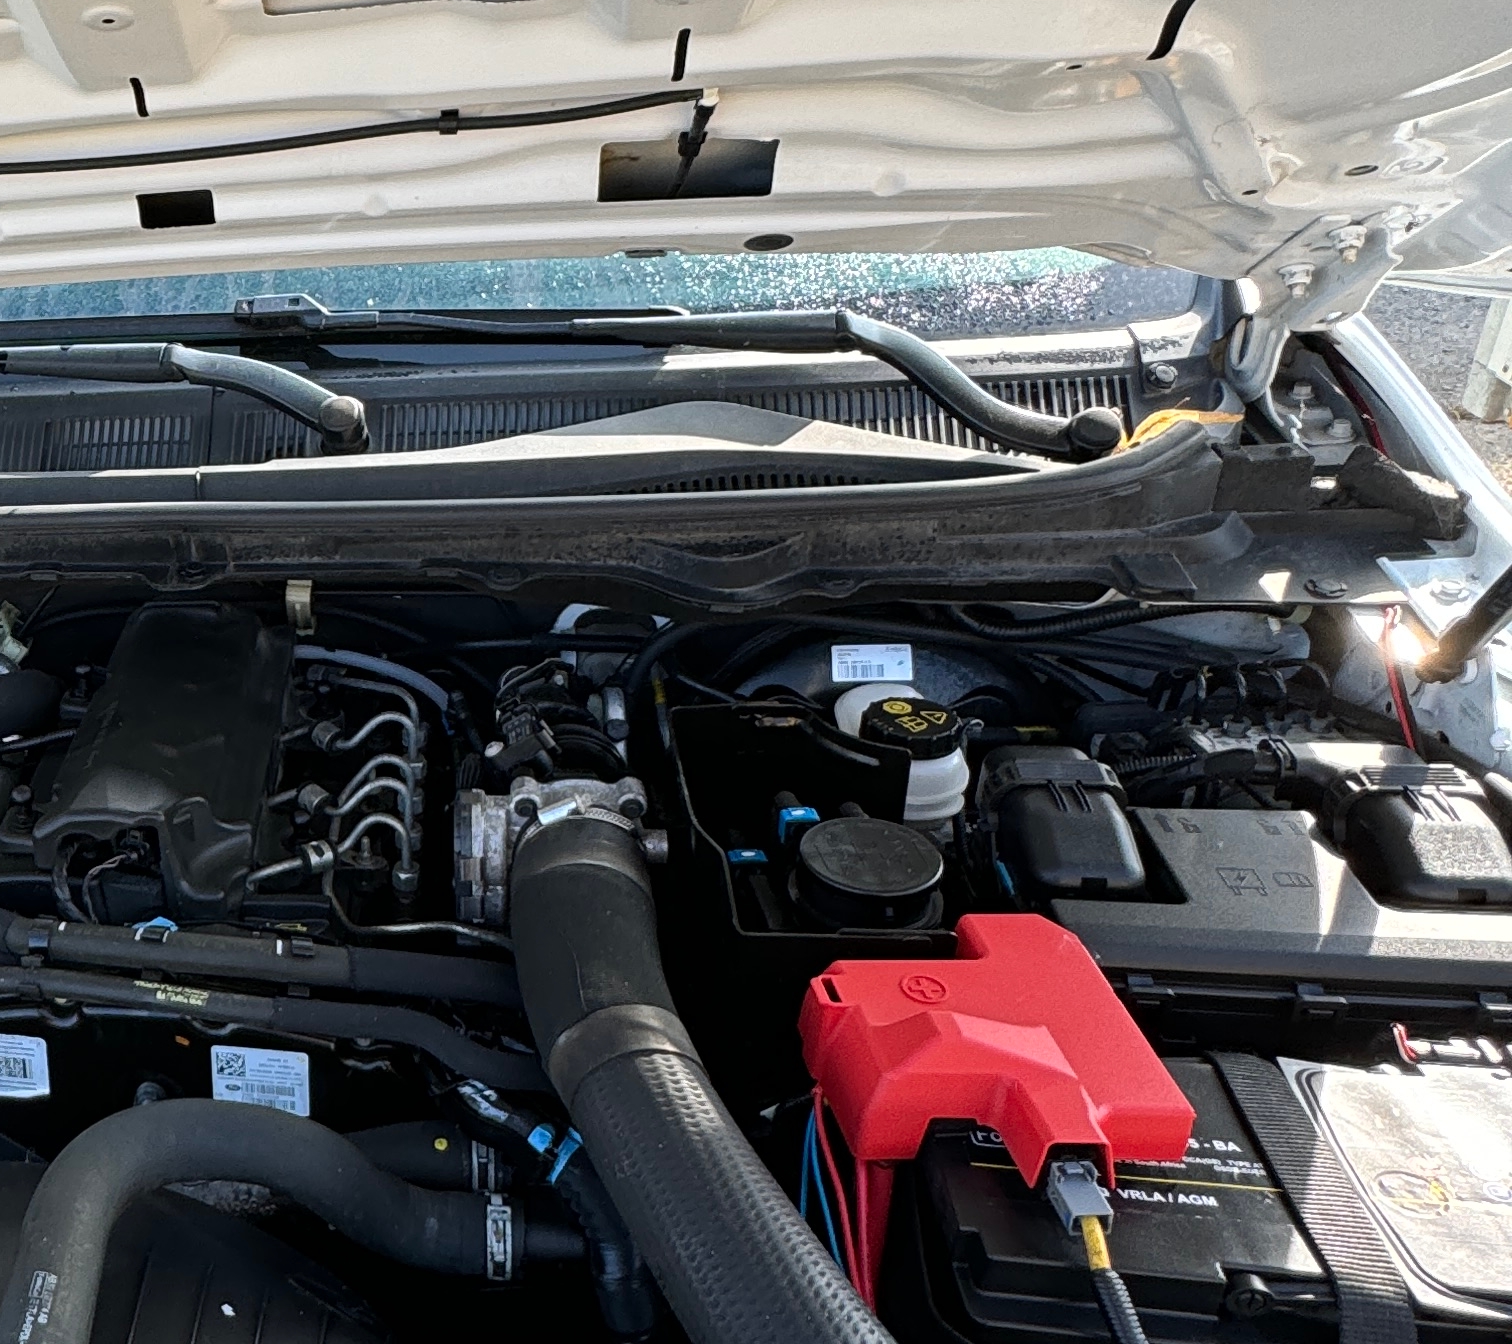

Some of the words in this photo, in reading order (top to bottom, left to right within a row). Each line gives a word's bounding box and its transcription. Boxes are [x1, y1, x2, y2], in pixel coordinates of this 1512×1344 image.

[1211, 1139, 1244, 1153] BA
[1116, 1187, 1168, 1204] VRLA
[1177, 1192, 1220, 1207] AGM
